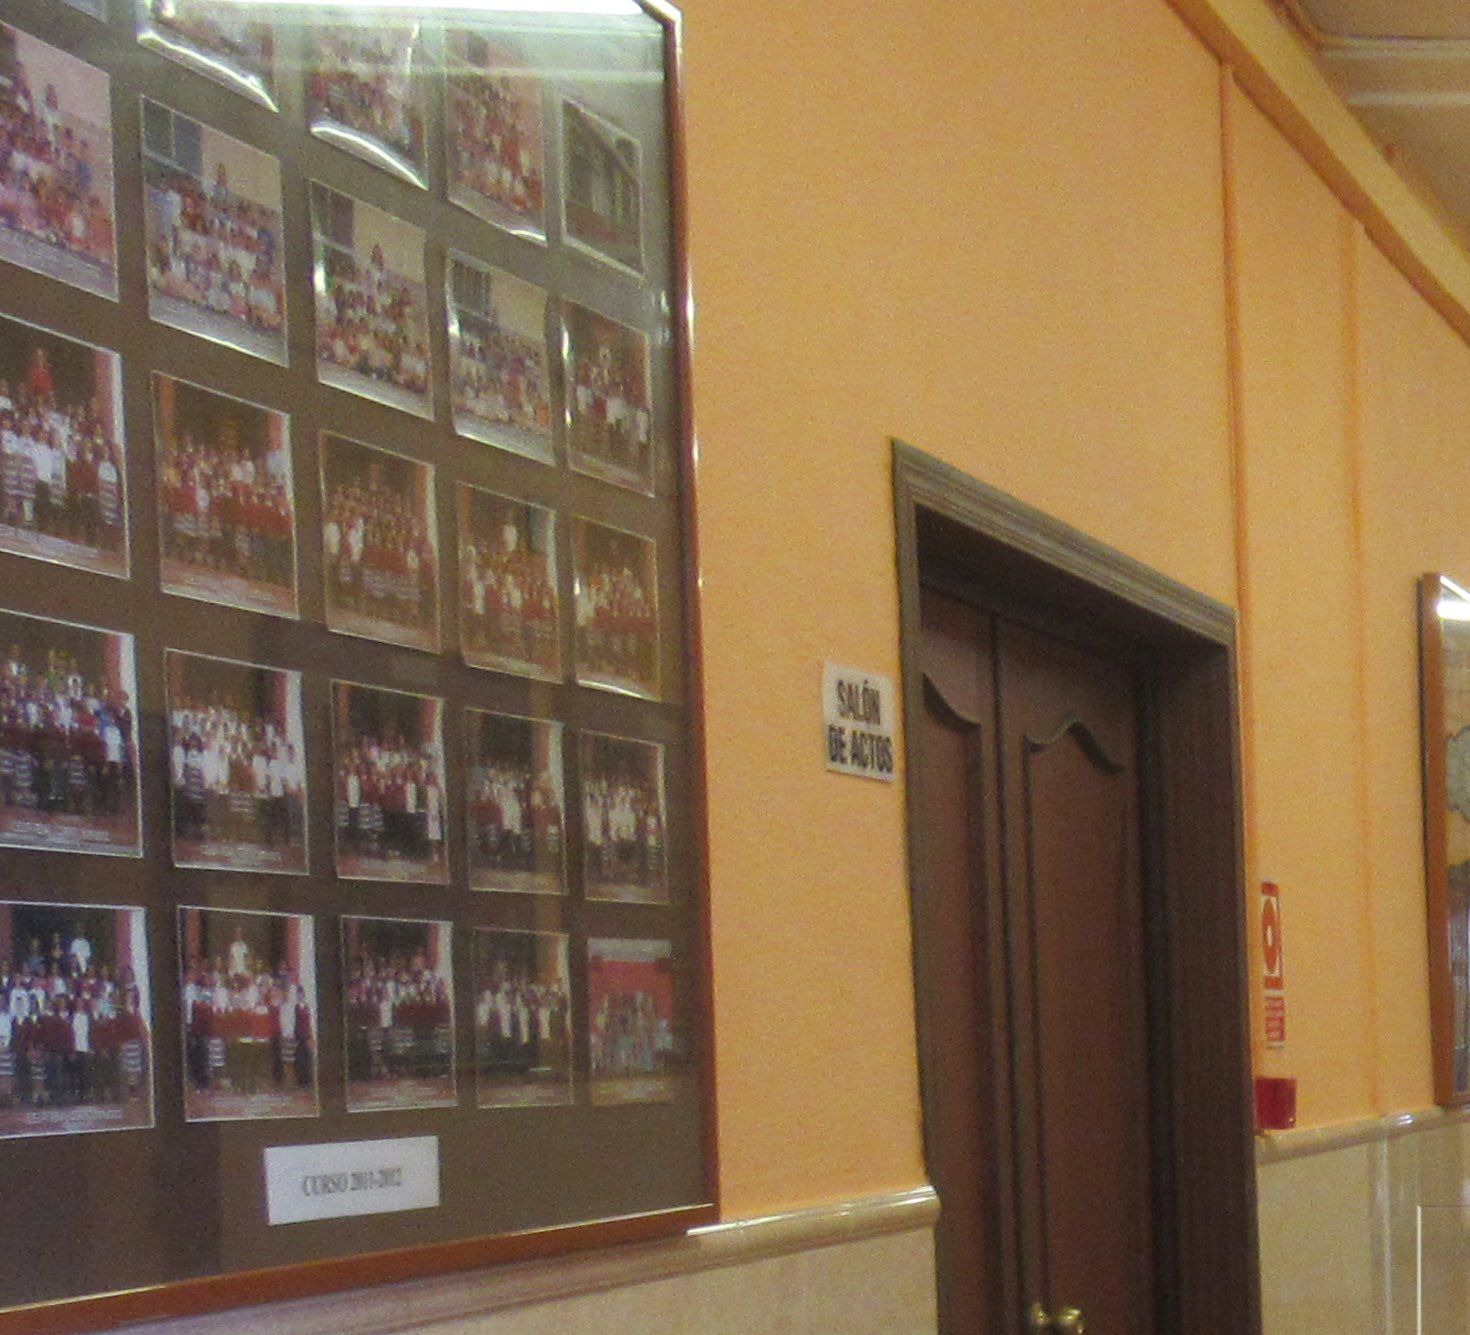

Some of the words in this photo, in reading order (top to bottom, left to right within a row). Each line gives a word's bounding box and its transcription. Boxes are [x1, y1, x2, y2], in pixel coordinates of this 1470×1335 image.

[828, 723, 848, 764] DE
[850, 729, 893, 774] ACTOS
[303, 1171, 348, 1197] CURSO
